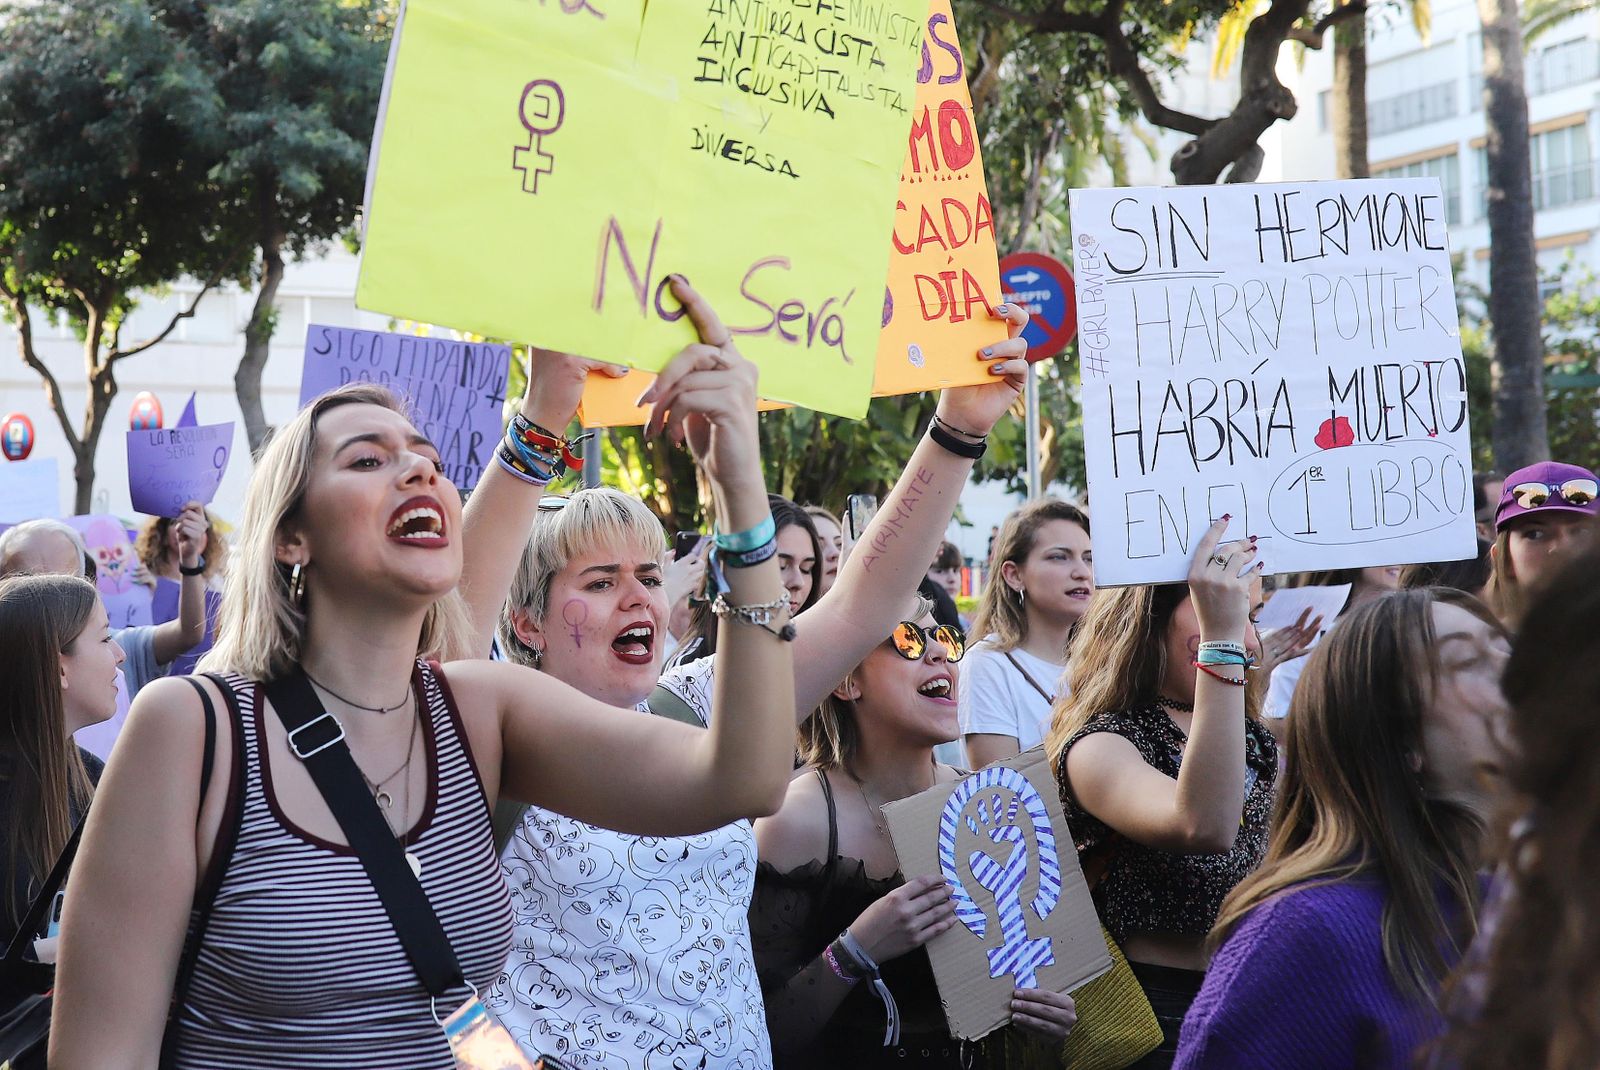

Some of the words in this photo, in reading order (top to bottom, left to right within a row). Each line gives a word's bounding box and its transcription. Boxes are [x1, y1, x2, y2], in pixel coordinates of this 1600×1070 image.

[790, 0, 921, 55] FEMINISTA
[892, 191, 996, 255] CADA
[1104, 196, 1209, 275] SIN
[1254, 191, 1445, 263] HERMIONE
[727, 255, 854, 365] Será
[914, 255, 994, 323] DÍA
[1131, 278, 1288, 368] HARRY
[1301, 264, 1453, 356] POTTER
[313, 328, 384, 367] SIGO
[1108, 357, 1297, 479] HABRÍA
[1327, 357, 1467, 444] MUERTO
[1124, 485, 1190, 560] EN
[1207, 481, 1273, 546] EL
[1346, 454, 1467, 531] LIBRO
